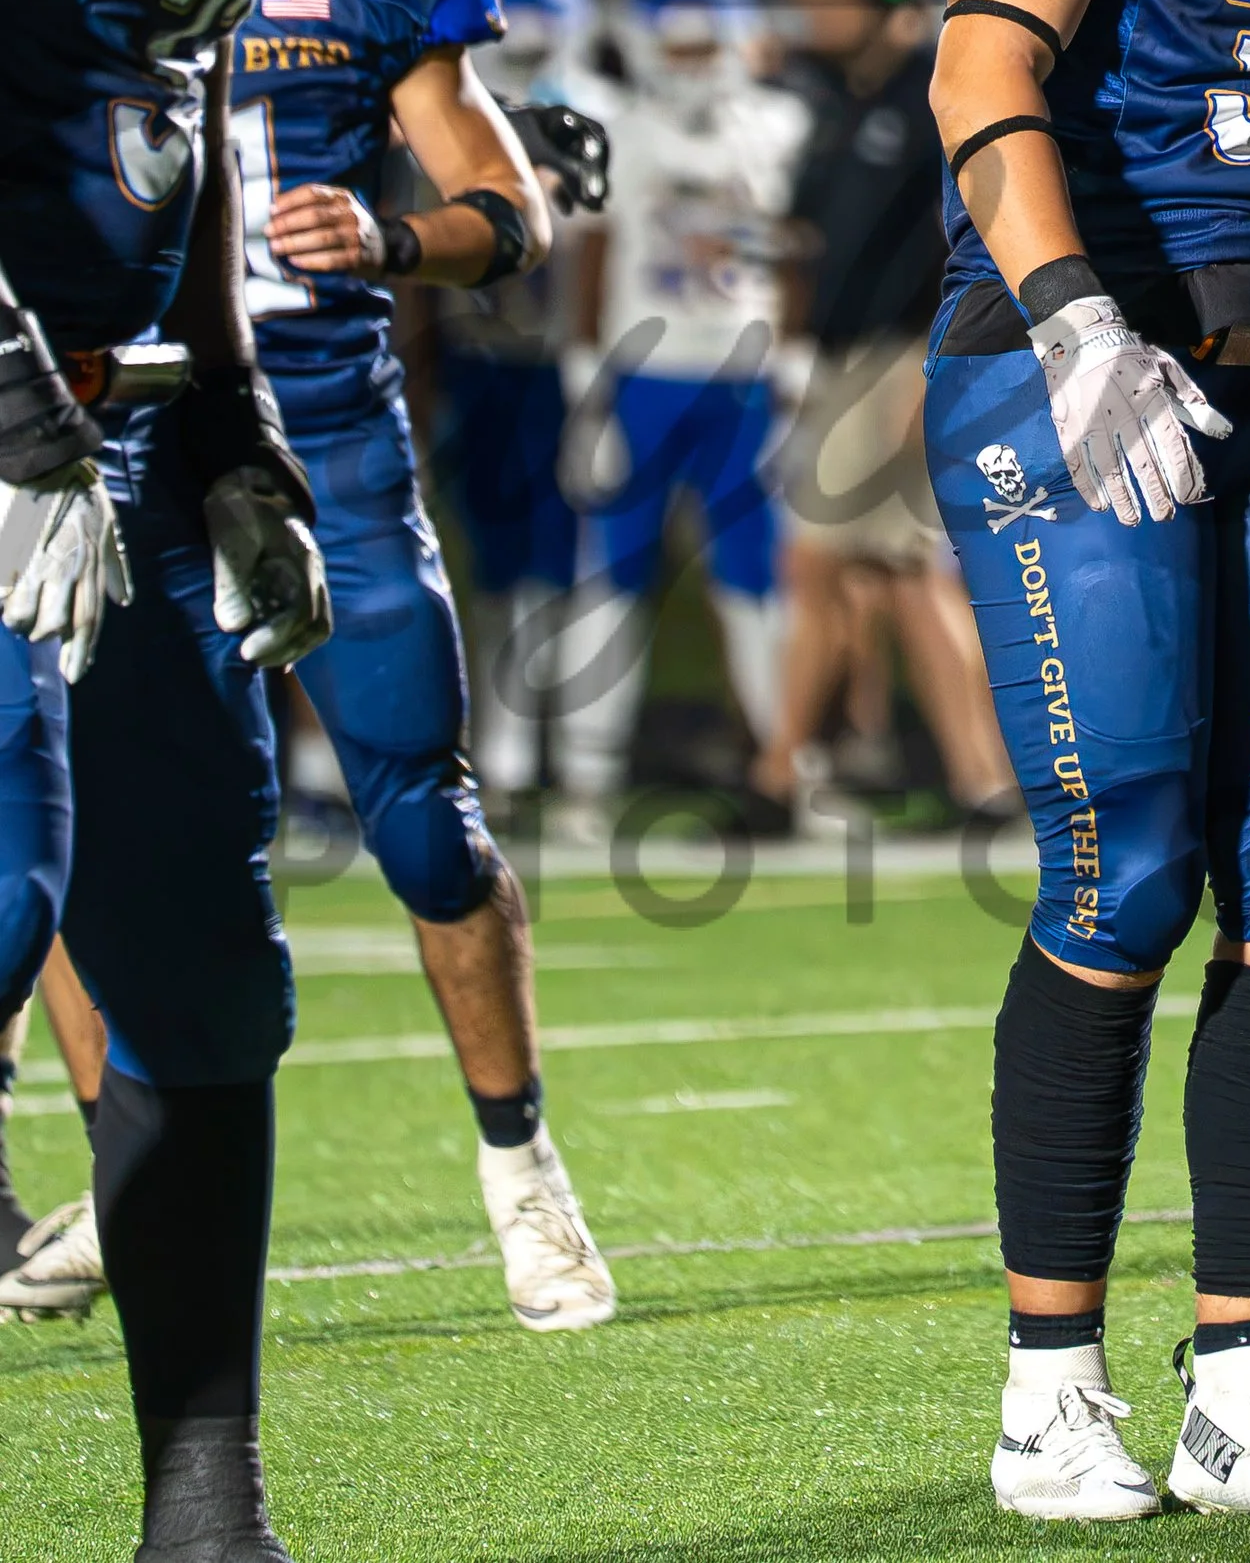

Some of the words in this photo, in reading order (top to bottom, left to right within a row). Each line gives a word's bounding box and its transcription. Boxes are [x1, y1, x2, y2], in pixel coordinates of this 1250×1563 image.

[241, 37, 350, 72] BYRD
[1014, 538, 1059, 649] DON'T
[1040, 657, 1076, 745] GIVE
[1053, 752, 1089, 800] UP
[1070, 807, 1101, 879] THE
[1180, 1404, 1246, 1485] NIKE
